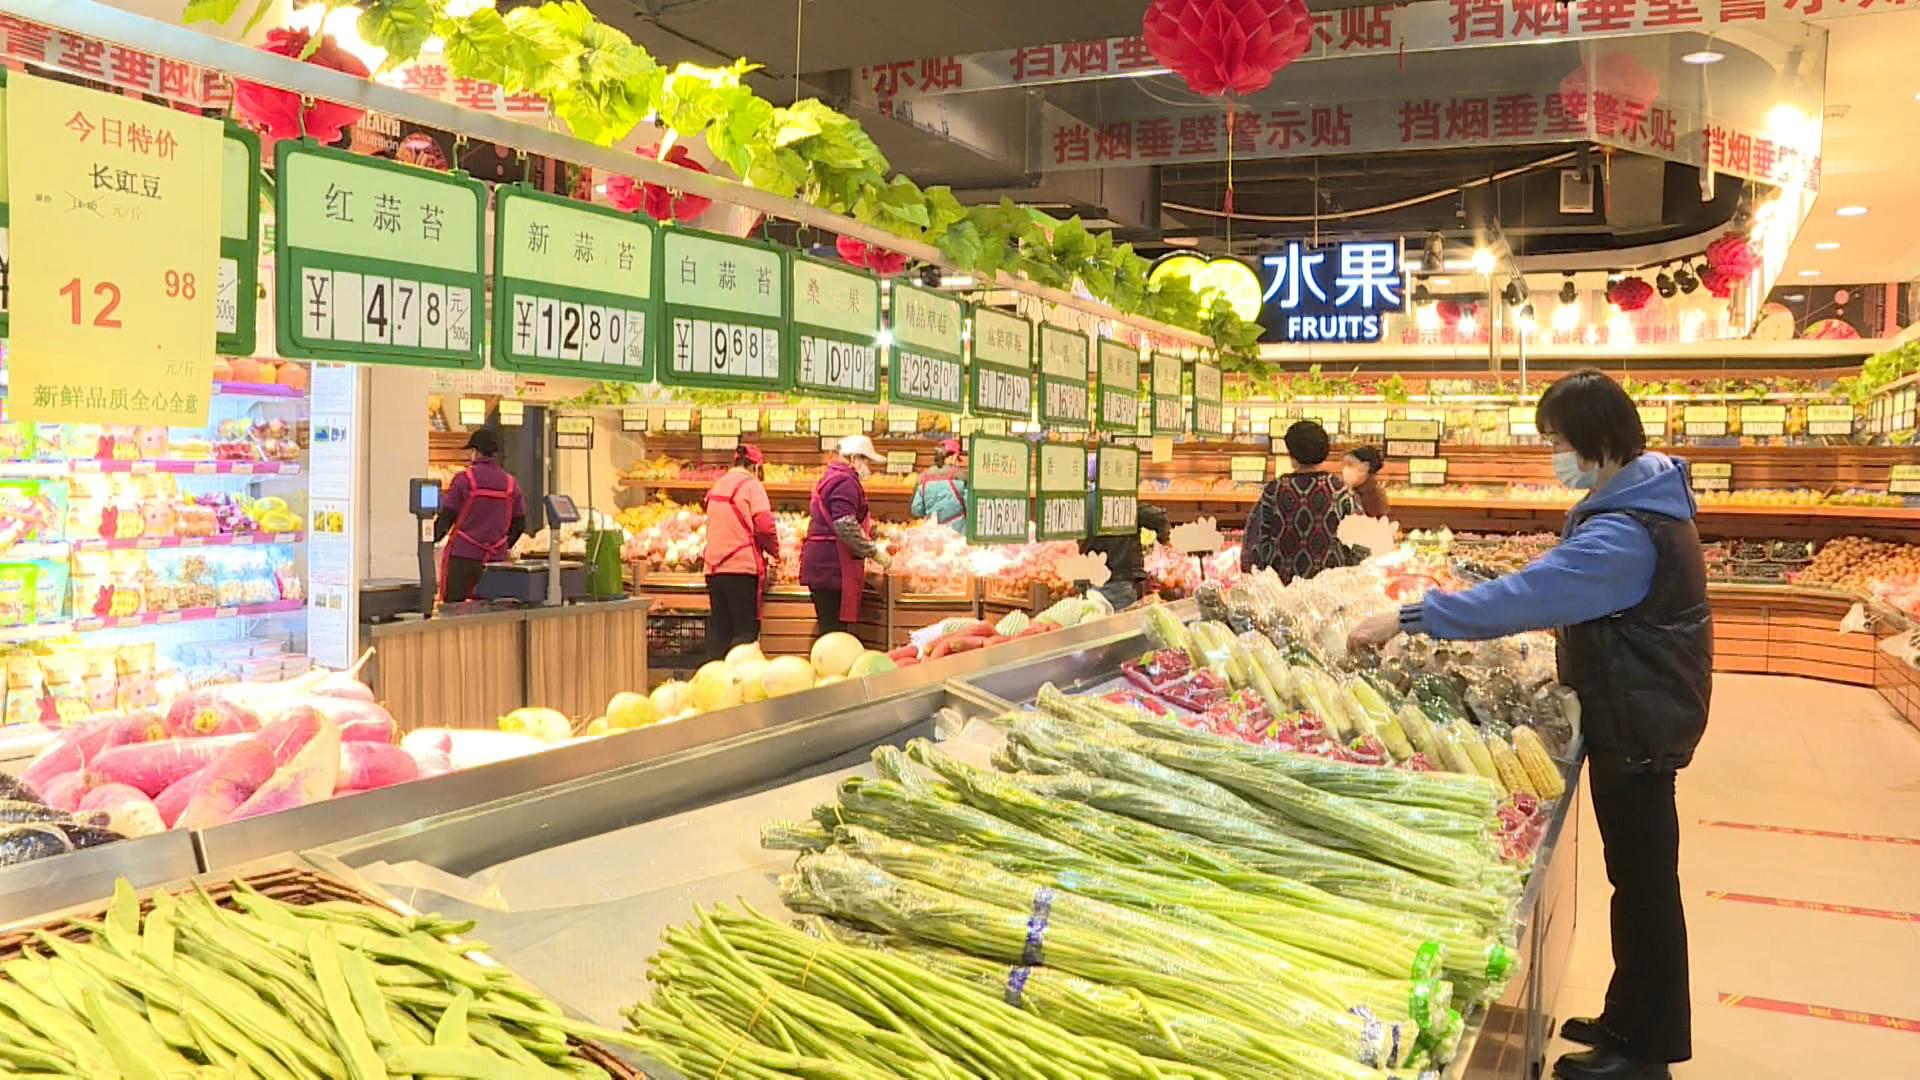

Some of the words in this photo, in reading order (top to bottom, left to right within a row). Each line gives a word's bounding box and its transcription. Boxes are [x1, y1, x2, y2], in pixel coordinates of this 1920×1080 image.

[65, 111, 178, 161] 今日特价
[1053, 104, 1353, 165] 挡烟垂壁警示贴
[1399, 90, 1677, 153] 挡烟垂壁警示贴
[88, 163, 162, 200] 长豇豆
[324, 182, 445, 242] 红蒜苔
[527, 221, 636, 272] 新蒜苔
[681, 255, 772, 295] 白蒜苔
[1262, 242, 1401, 308] 水果
[1288, 315, 1379, 340] FRUITS
[33, 384, 198, 415] 新鲜品质全心全意
